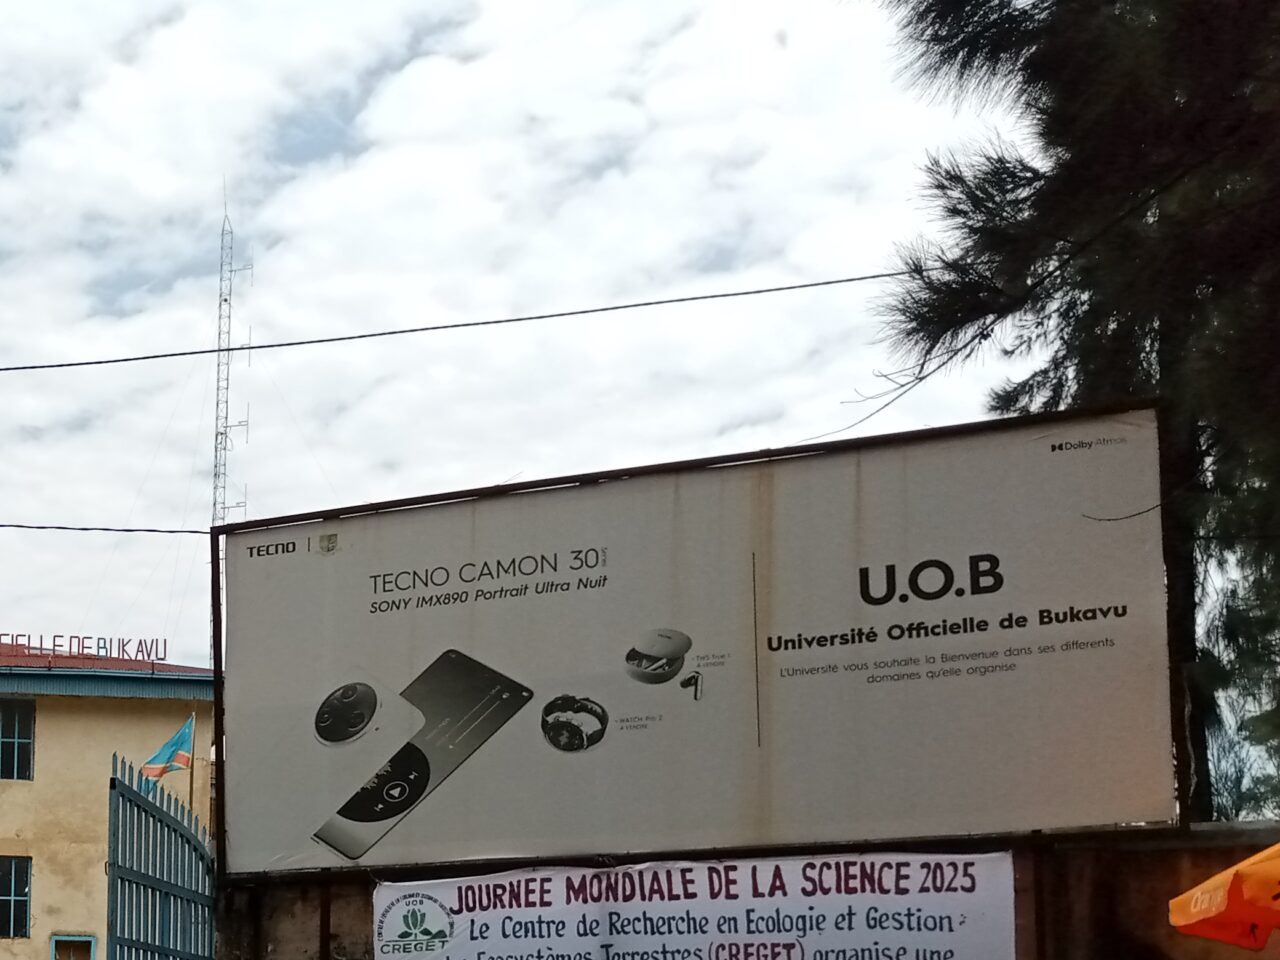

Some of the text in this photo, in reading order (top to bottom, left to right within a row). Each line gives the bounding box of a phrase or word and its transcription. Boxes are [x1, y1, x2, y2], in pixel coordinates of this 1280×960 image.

[1064, 440, 1093, 451] Dolby
[246, 541, 296, 558] TECNO
[369, 547, 599, 594] TECNO CAMON 30
[858, 553, 1004, 606] U.O.B
[369, 574, 607, 614] SONY IMX890 Portrait Ultra Nuit
[766, 603, 1128, 653] Université Officielle de Bukavu
[69, 635, 93, 657] DE
[96, 637, 168, 661] BUKAVU
[780, 662, 839, 679] L'Université
[843, 662, 869, 672] vous
[873, 655, 920, 670] souhaite
[925, 654, 936, 664] la
[940, 649, 999, 664] Bienvenue
[1004, 646, 1032, 658] dans
[1038, 644, 1056, 654] ses
[867, 663, 1017, 685] domaines qu'elle organise
[449, 861, 977, 915] JOURNEE MONDIALE DE LA SCIENCE 2025
[469, 918, 490, 941] Le
[501, 916, 566, 940] Centre
[576, 914, 598, 936] de
[608, 909, 709, 937] Recherche
[717, 913, 739, 934] en
[745, 906, 825, 938] Ecologie
[834, 905, 856, 931] et
[380, 940, 449, 954] CREGET
